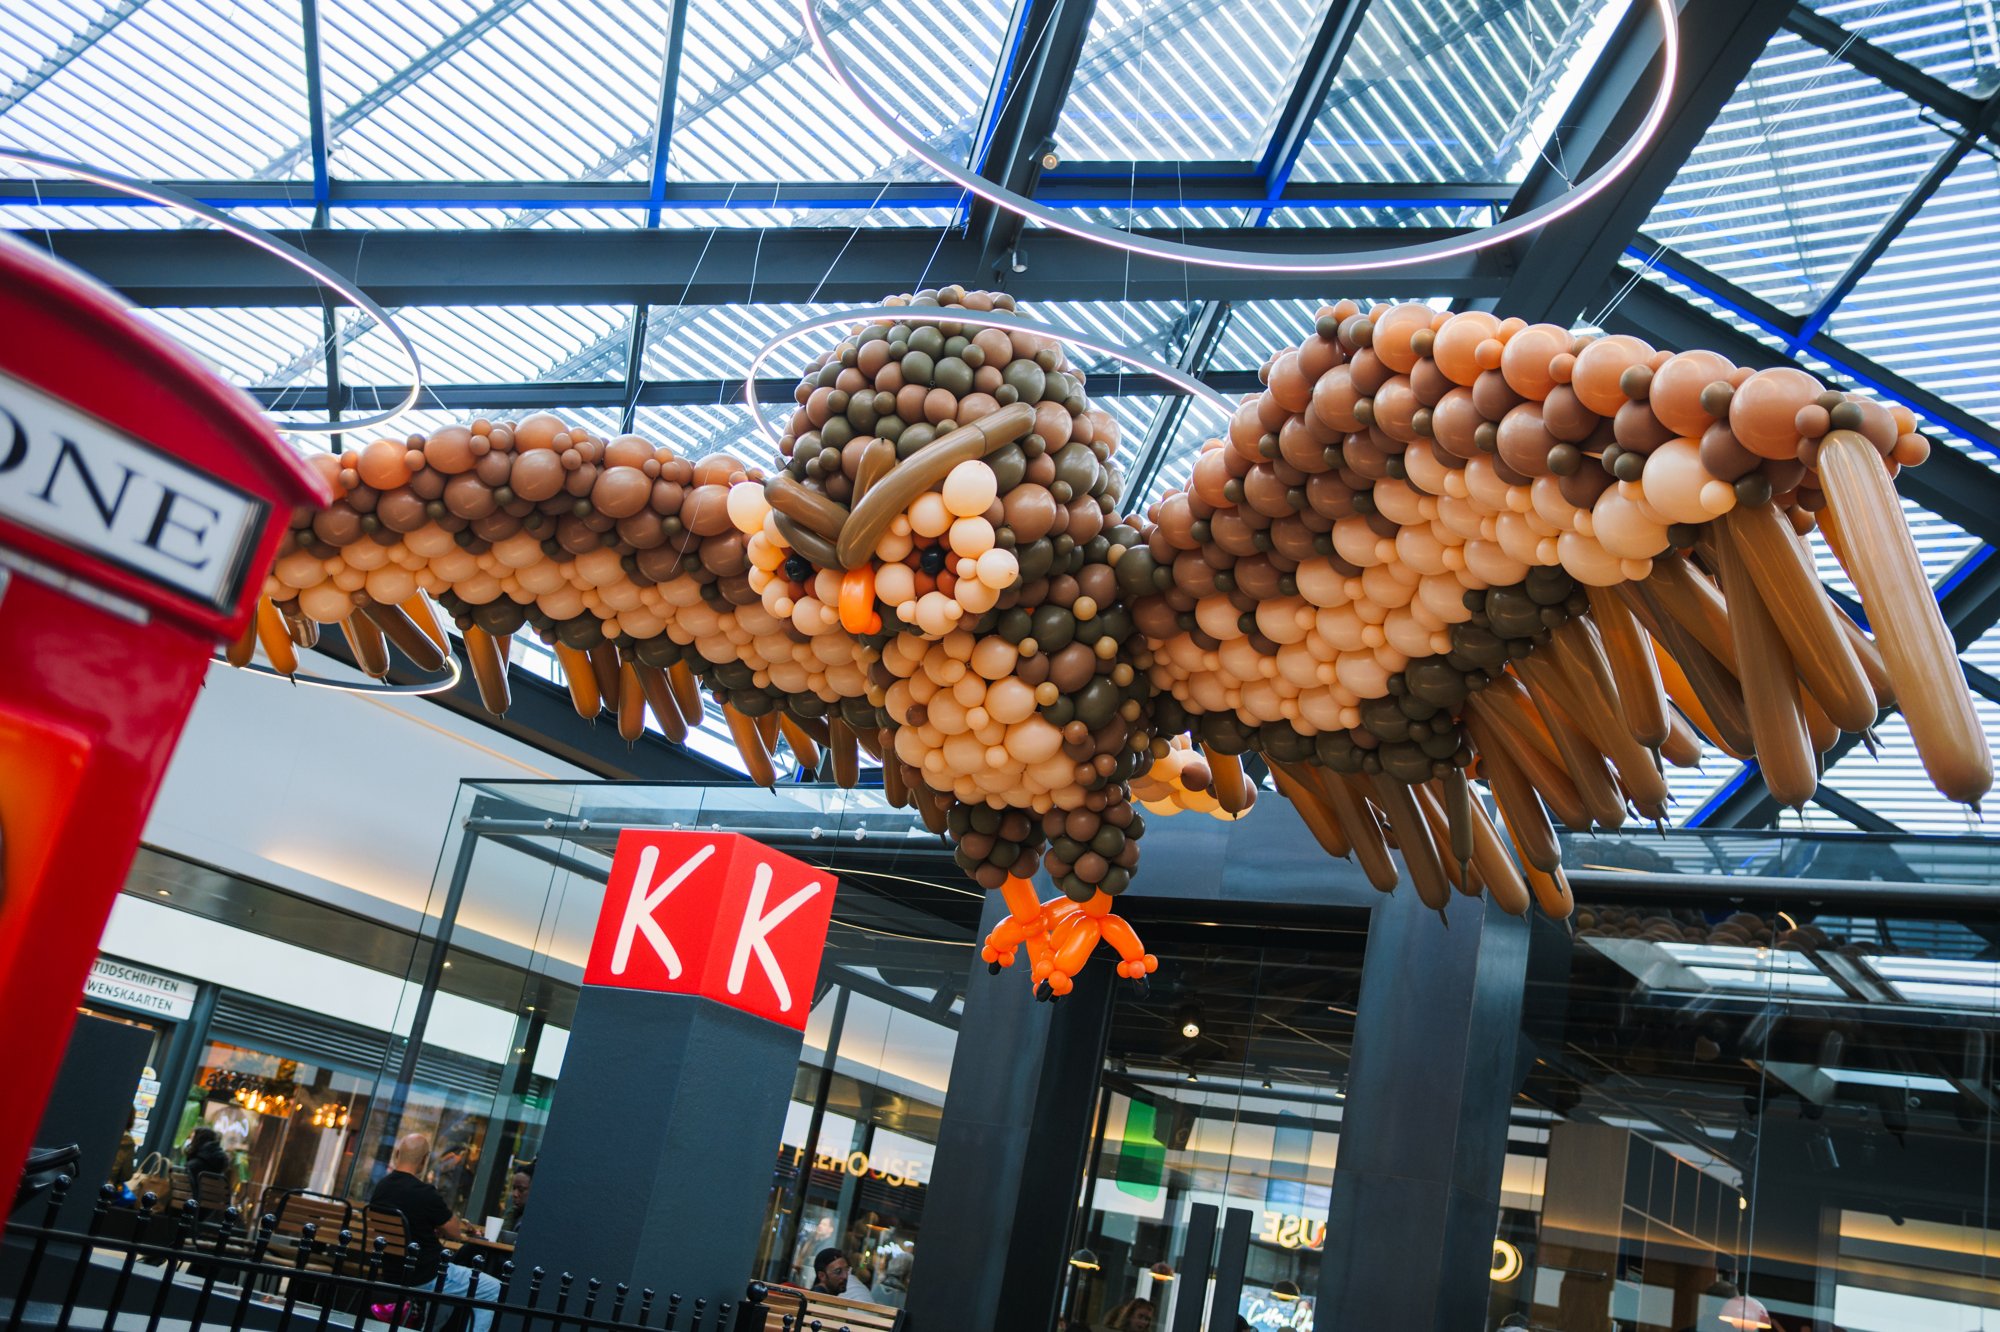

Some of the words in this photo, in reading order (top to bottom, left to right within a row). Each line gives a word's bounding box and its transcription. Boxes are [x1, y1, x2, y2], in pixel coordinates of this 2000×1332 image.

[610, 844, 716, 980] K
[727, 862, 822, 1012] K
[87, 979, 174, 1012] WENSKAARTEN
[94, 960, 180, 993] TIJDSCHRIFTEN
